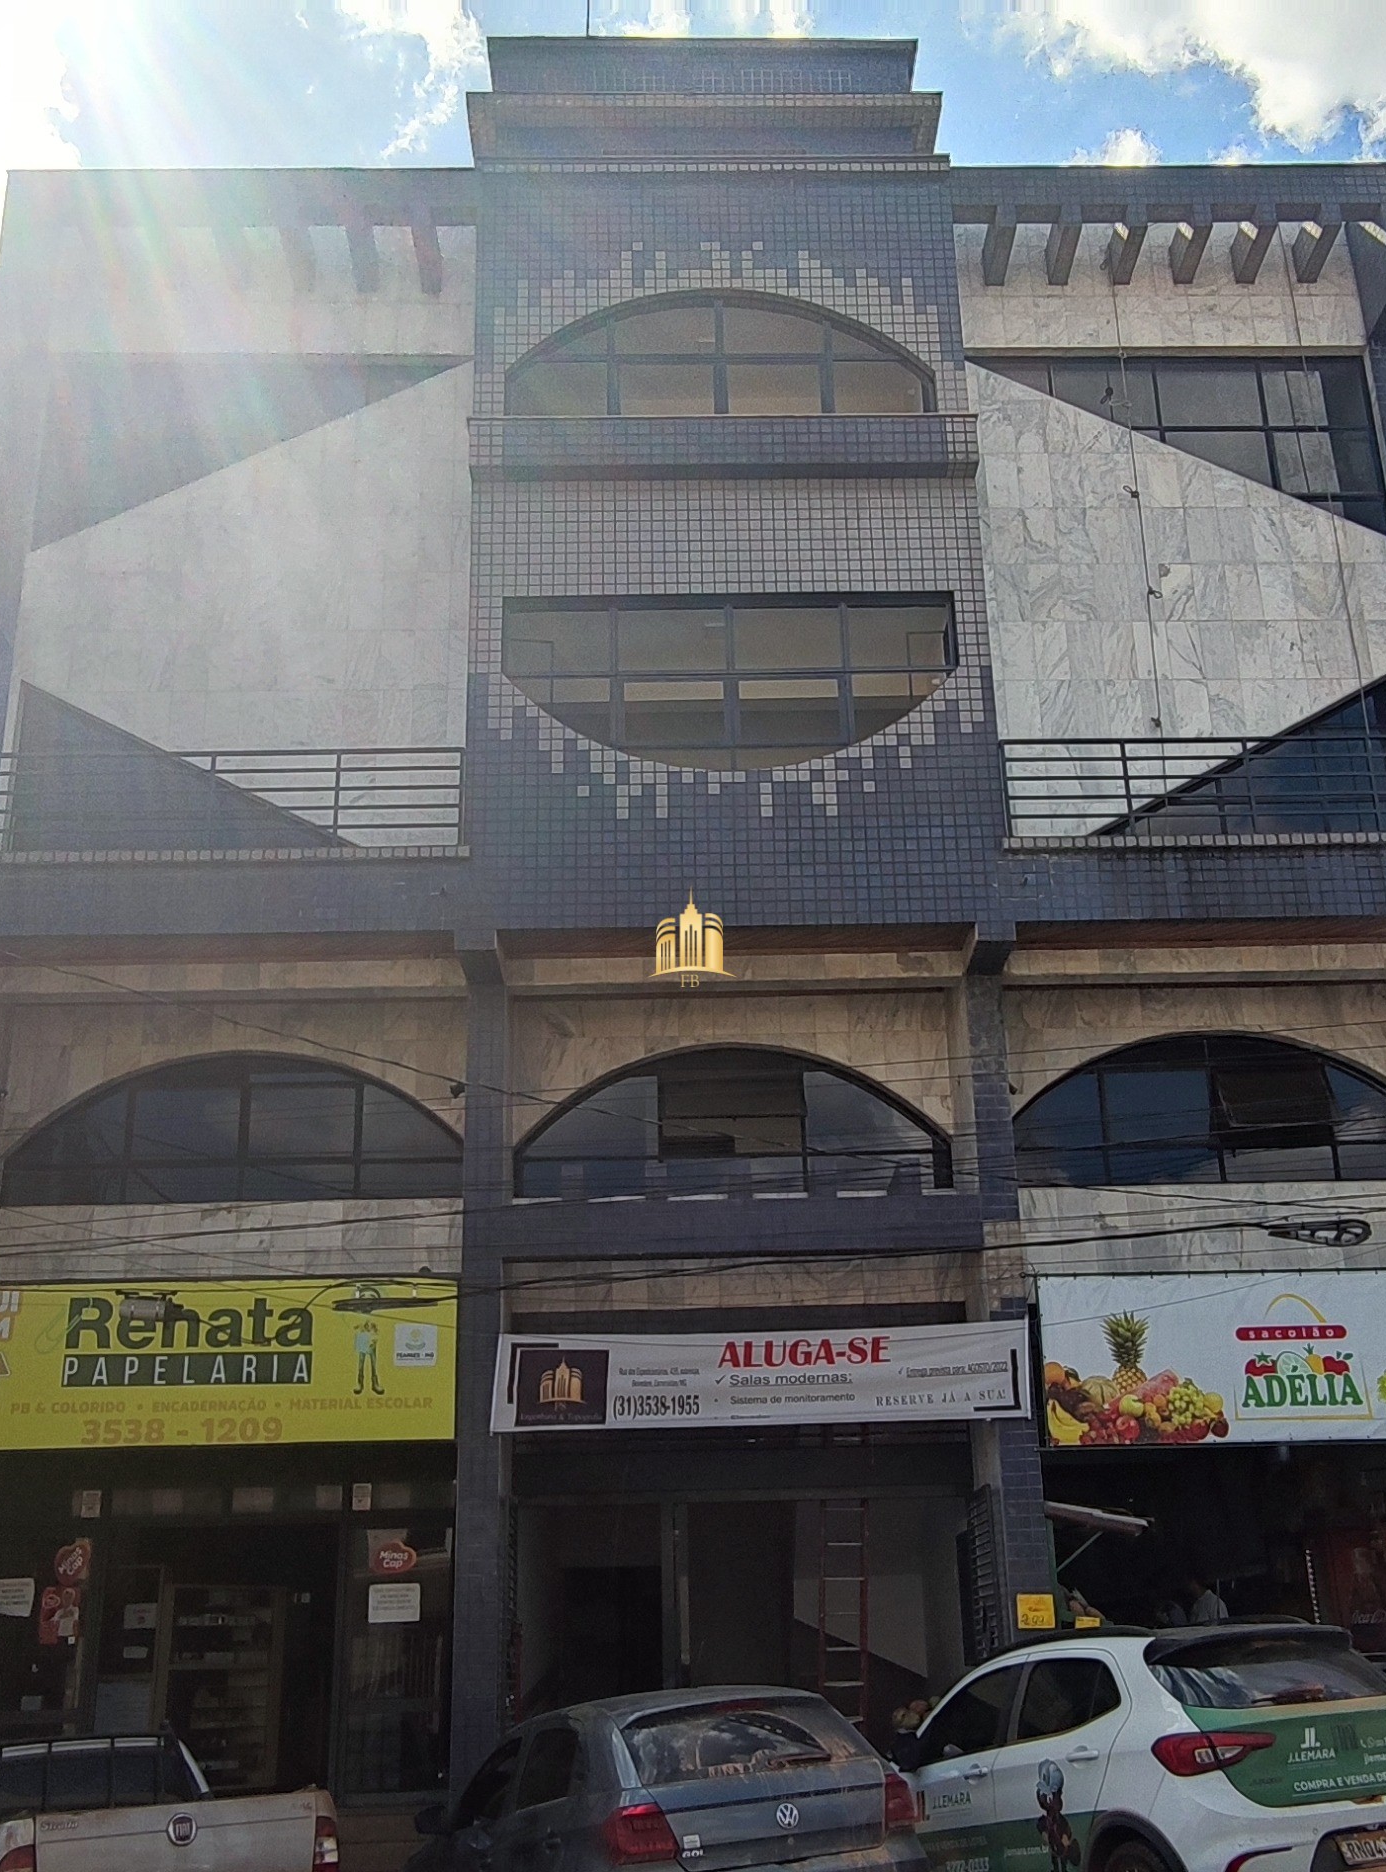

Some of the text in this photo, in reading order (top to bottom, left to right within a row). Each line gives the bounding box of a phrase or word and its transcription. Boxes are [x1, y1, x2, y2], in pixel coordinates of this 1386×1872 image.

[65, 1297, 313, 1349] Renata
[1248, 1327, 1335, 1339] sacolão
[717, 1336, 891, 1369] ALUGA-SE
[63, 1354, 309, 1386] PAPELARIA
[729, 1374, 771, 1386] Salas
[1242, 1365, 1364, 1408] ADÉLIA
[10, 1402, 30, 1415] PB
[51, 1401, 126, 1414] COLORIDO
[152, 1398, 267, 1414] ENCADERNAÇÃO
[290, 1398, 362, 1412] MATERIAL
[366, 1397, 434, 1410] ESCOLAR
[730, 1393, 856, 1405] Sistema de monitoramento
[876, 1389, 1007, 1407] RESERVE JÁ A SUA!
[80, 1418, 165, 1446] 3538
[200, 1417, 283, 1443] 1209
[379, 1550, 410, 1561] Minas
[382, 1559, 403, 1570] Cap
[1288, 1747, 1337, 1764] J.LEMARA
[1293, 1778, 1337, 1793] COMPRA
[1338, 1777, 1344, 1787] E
[1344, 1773, 1375, 1786] VENDA
